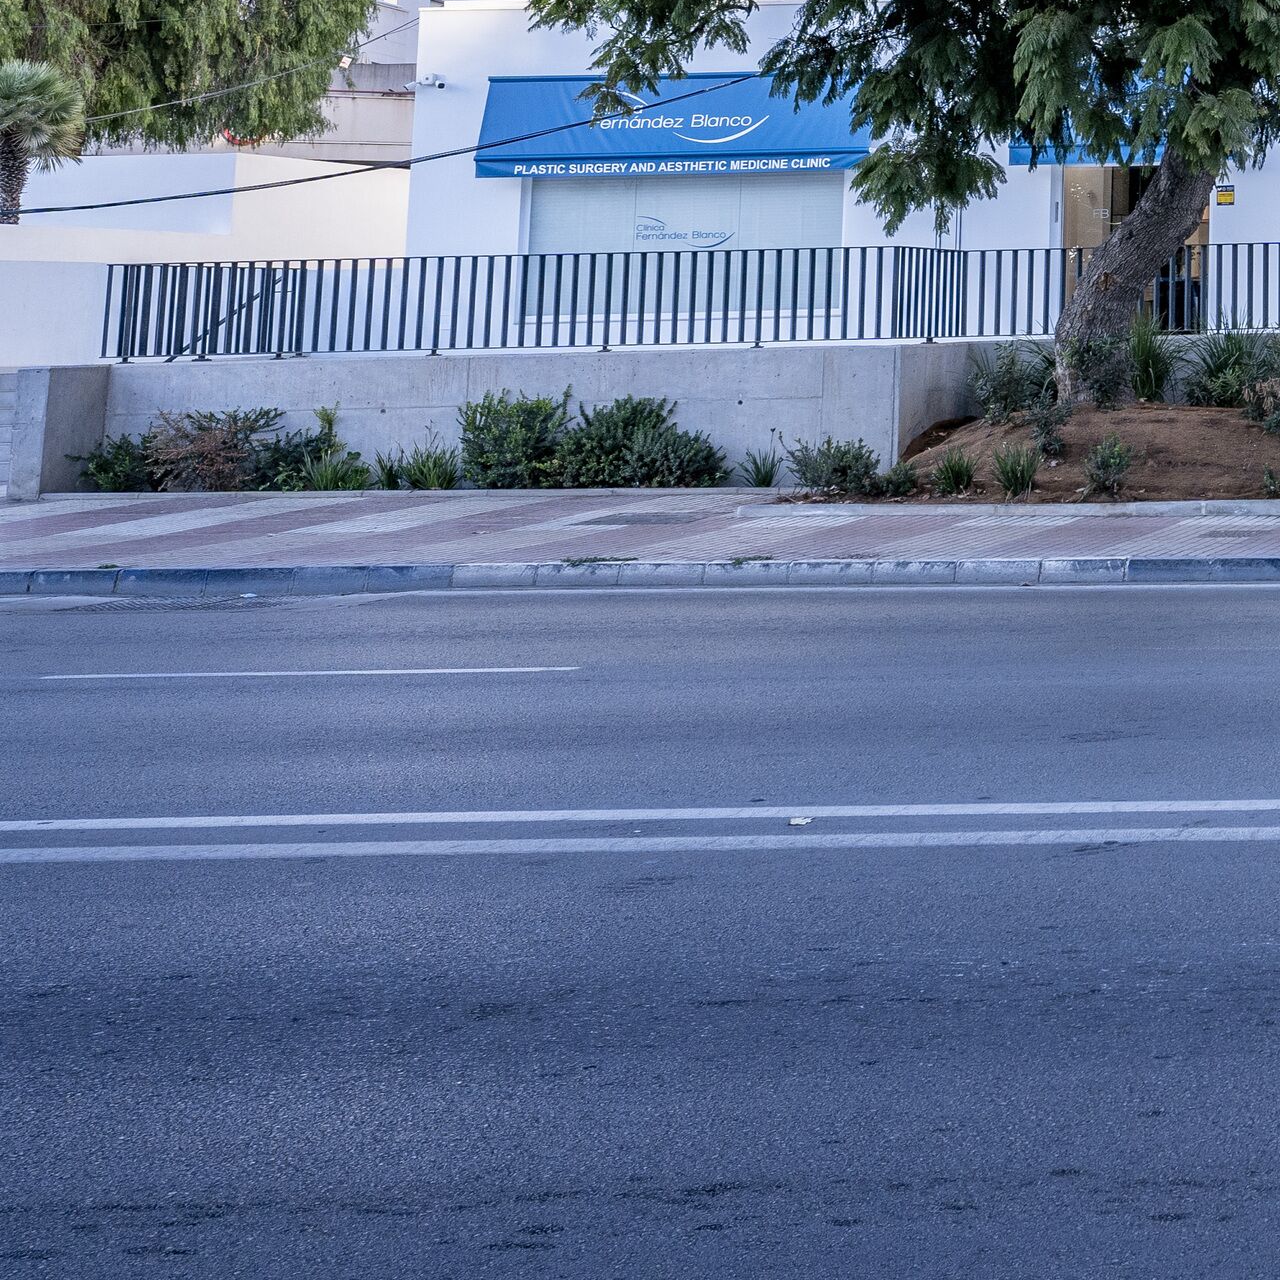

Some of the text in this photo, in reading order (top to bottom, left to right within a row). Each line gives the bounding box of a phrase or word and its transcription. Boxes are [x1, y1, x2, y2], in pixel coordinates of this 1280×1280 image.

[690, 113, 752, 128] Blanco
[514, 157, 831, 175] PLASTIC SURGERY AND AESTHETIC MEDICINE CLINIC
[635, 230, 727, 240] Fernández Blanco
